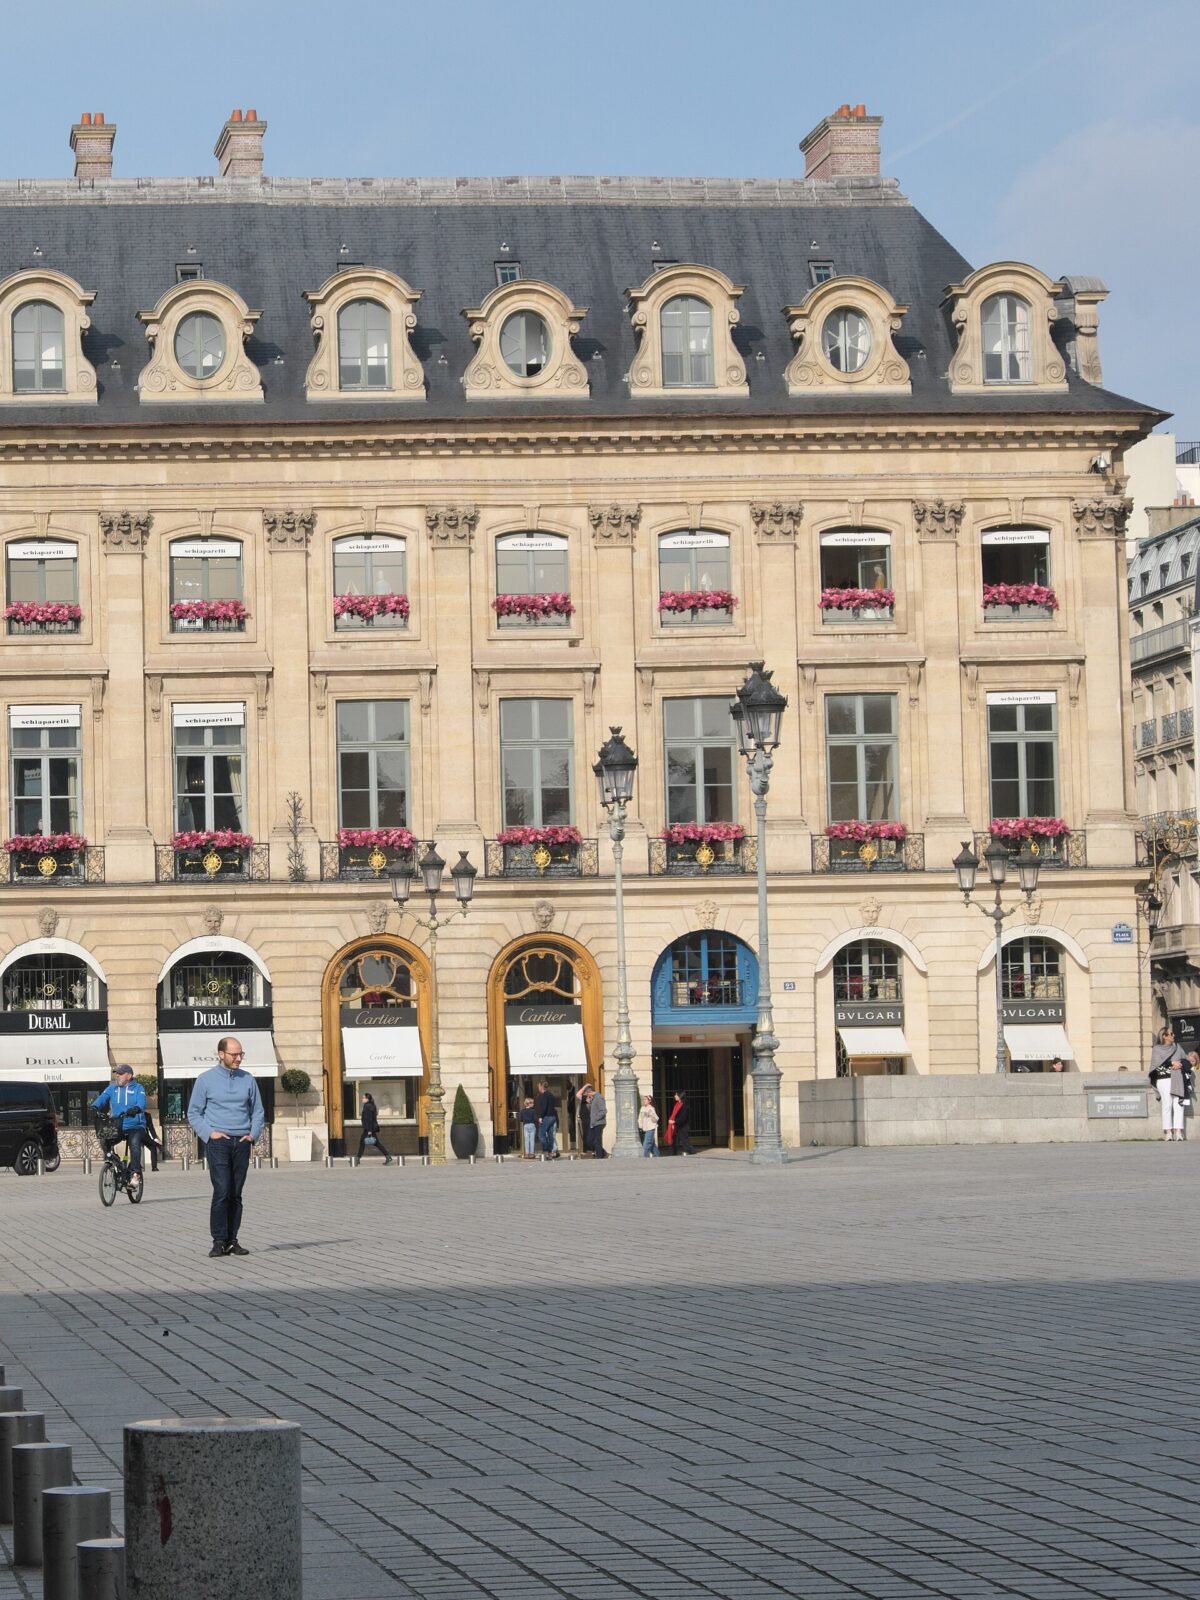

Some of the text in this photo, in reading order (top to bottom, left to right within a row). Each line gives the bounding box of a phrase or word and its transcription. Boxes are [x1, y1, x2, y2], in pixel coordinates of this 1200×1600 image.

[672, 538, 714, 546] schiaparelli
[1000, 695, 1041, 703] schiaparelli
[21, 719, 70, 727] schiaparelli
[185, 717, 233, 725] schiaparelli
[355, 1010, 402, 1025] Cartier
[519, 1008, 567, 1023] Cartier
[837, 1011, 902, 1020] BVLGARI
[1002, 1009, 1062, 1017] BVLGARI
[28, 1013, 71, 1029] DUBAIL
[194, 1010, 236, 1026] DUBAIL
[25, 1056, 80, 1065] DUBAIL
